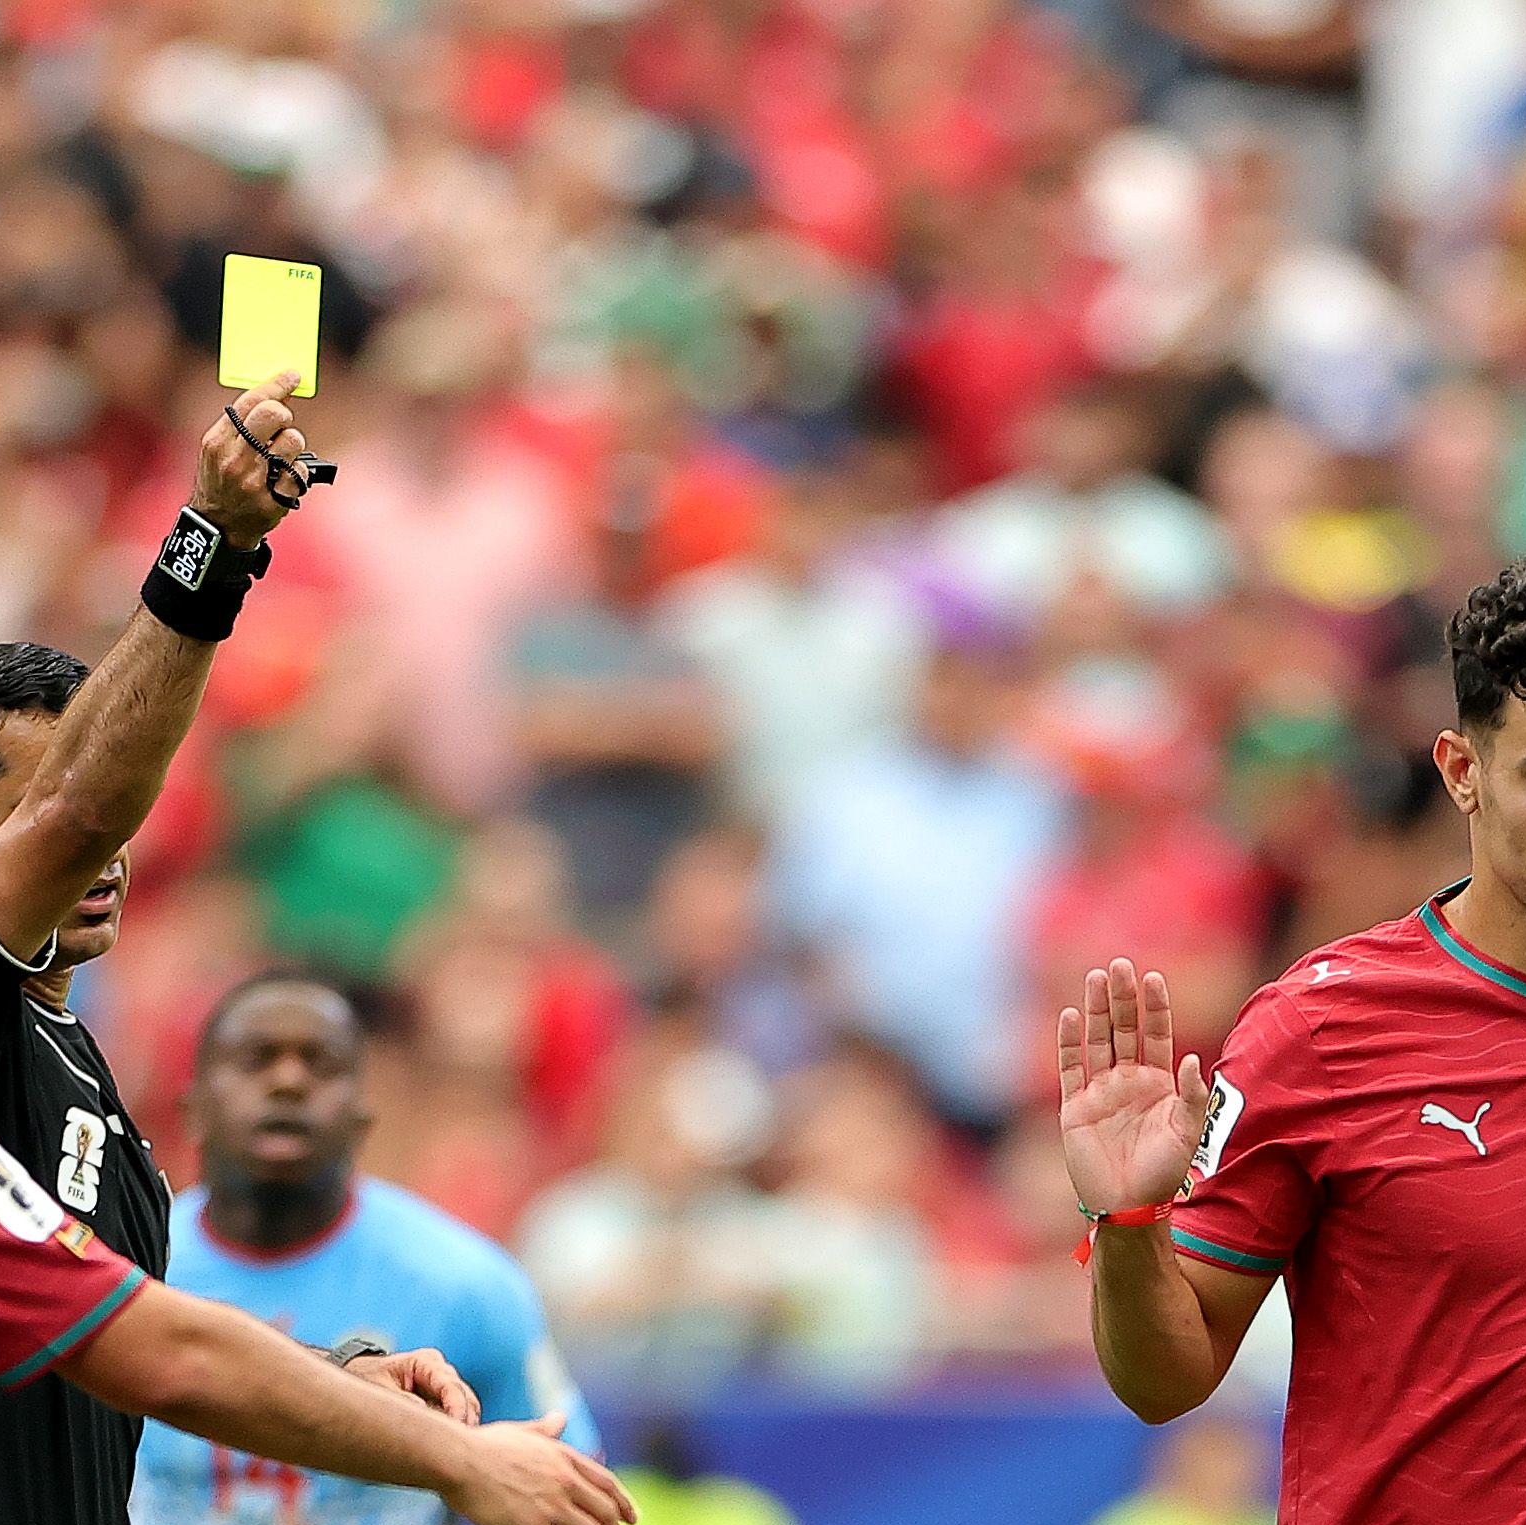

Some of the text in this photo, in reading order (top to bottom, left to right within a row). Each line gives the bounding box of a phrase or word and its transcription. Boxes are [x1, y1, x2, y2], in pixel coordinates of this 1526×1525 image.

[288, 268, 315, 280] FIFA
[172, 529, 208, 582] 46:48
[67, 1185, 86, 1201] FIFA
